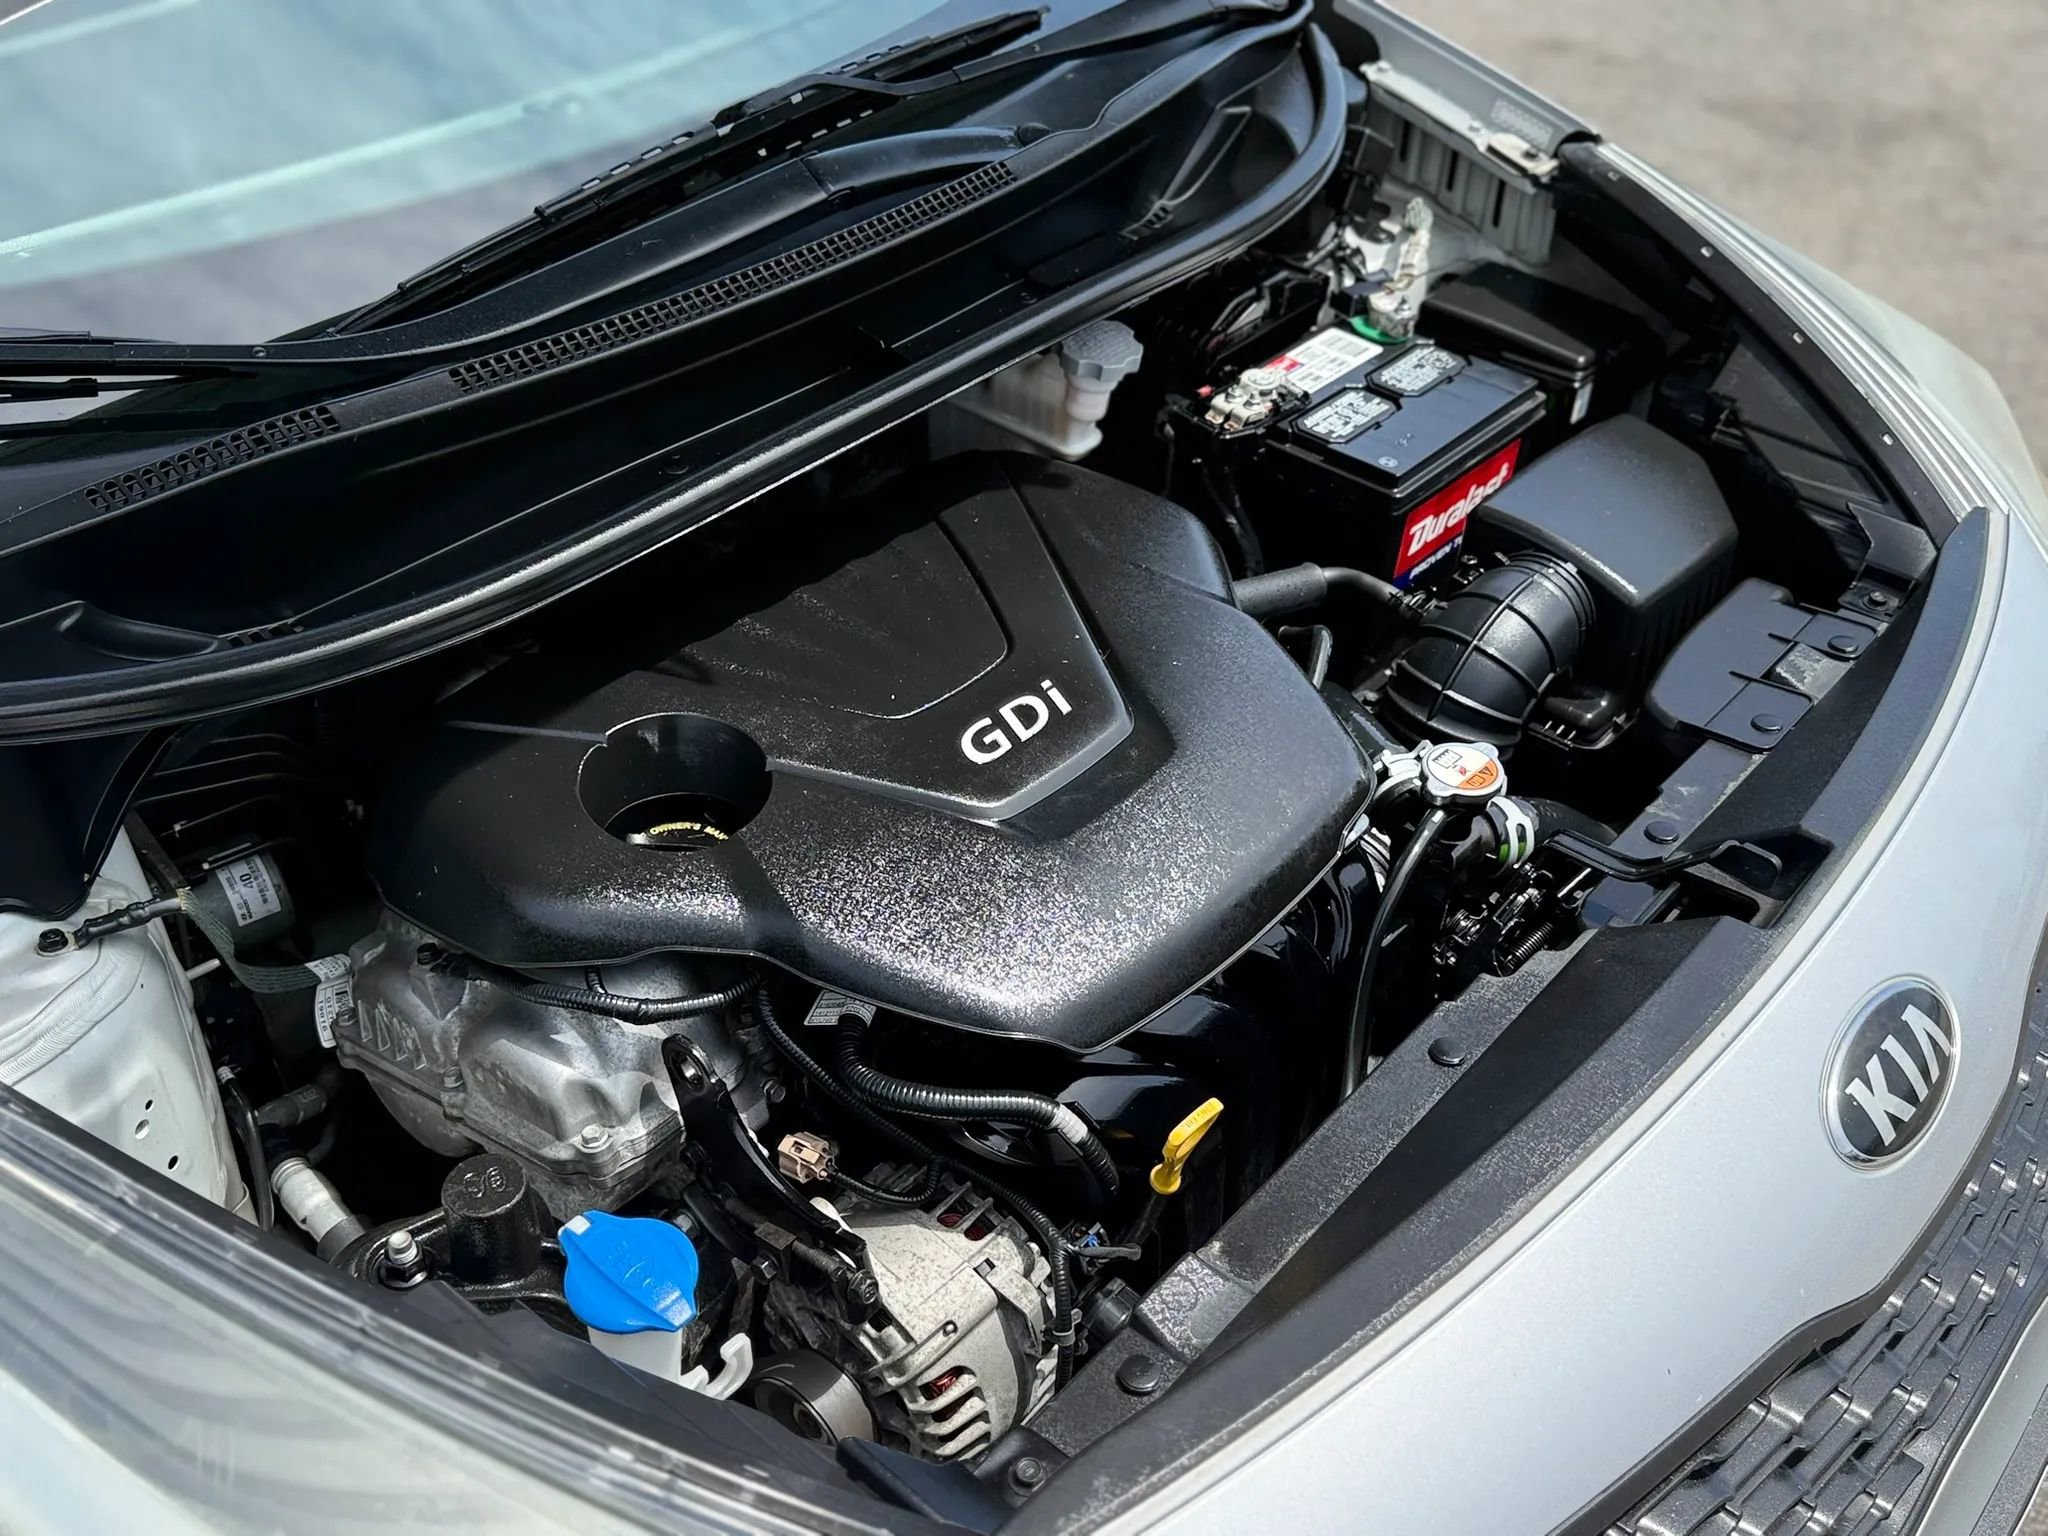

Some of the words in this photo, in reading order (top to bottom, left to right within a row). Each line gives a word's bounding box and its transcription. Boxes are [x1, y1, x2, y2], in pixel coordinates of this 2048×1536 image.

[1407, 462, 1509, 556] Duralast
[960, 679, 1072, 765] GDi
[650, 822, 701, 835] OWNER'S
[240, 873, 254, 889] 40
[1845, 1004, 1952, 1146] KIA
